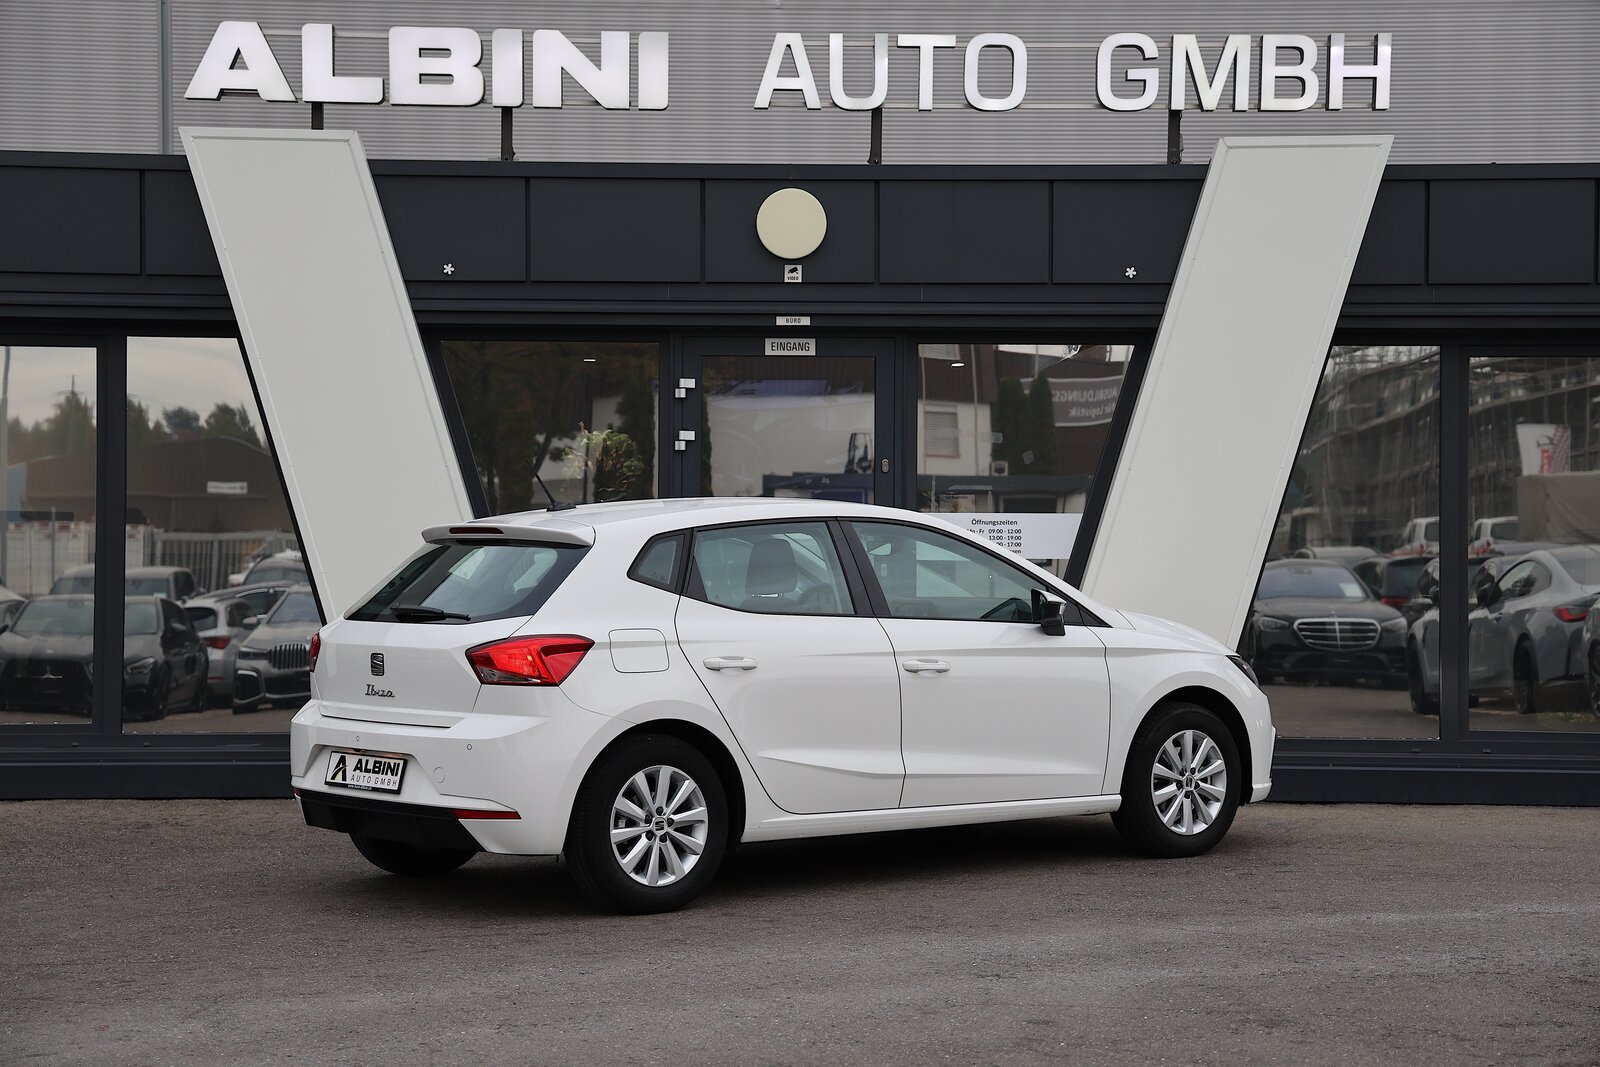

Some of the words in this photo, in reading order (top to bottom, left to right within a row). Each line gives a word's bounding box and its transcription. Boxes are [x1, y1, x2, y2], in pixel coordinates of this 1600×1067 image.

[184, 20, 670, 111] ALBINI
[754, 32, 1028, 111] AUTO
[1095, 32, 1393, 111] GMBH
[786, 316, 801, 324] BÜRO
[771, 341, 810, 352] EINGANG
[365, 684, 396, 698] Ibiza
[353, 758, 400, 776] ALBINI
[350, 774, 371, 783] AUTO
[374, 776, 398, 787] GMBH
